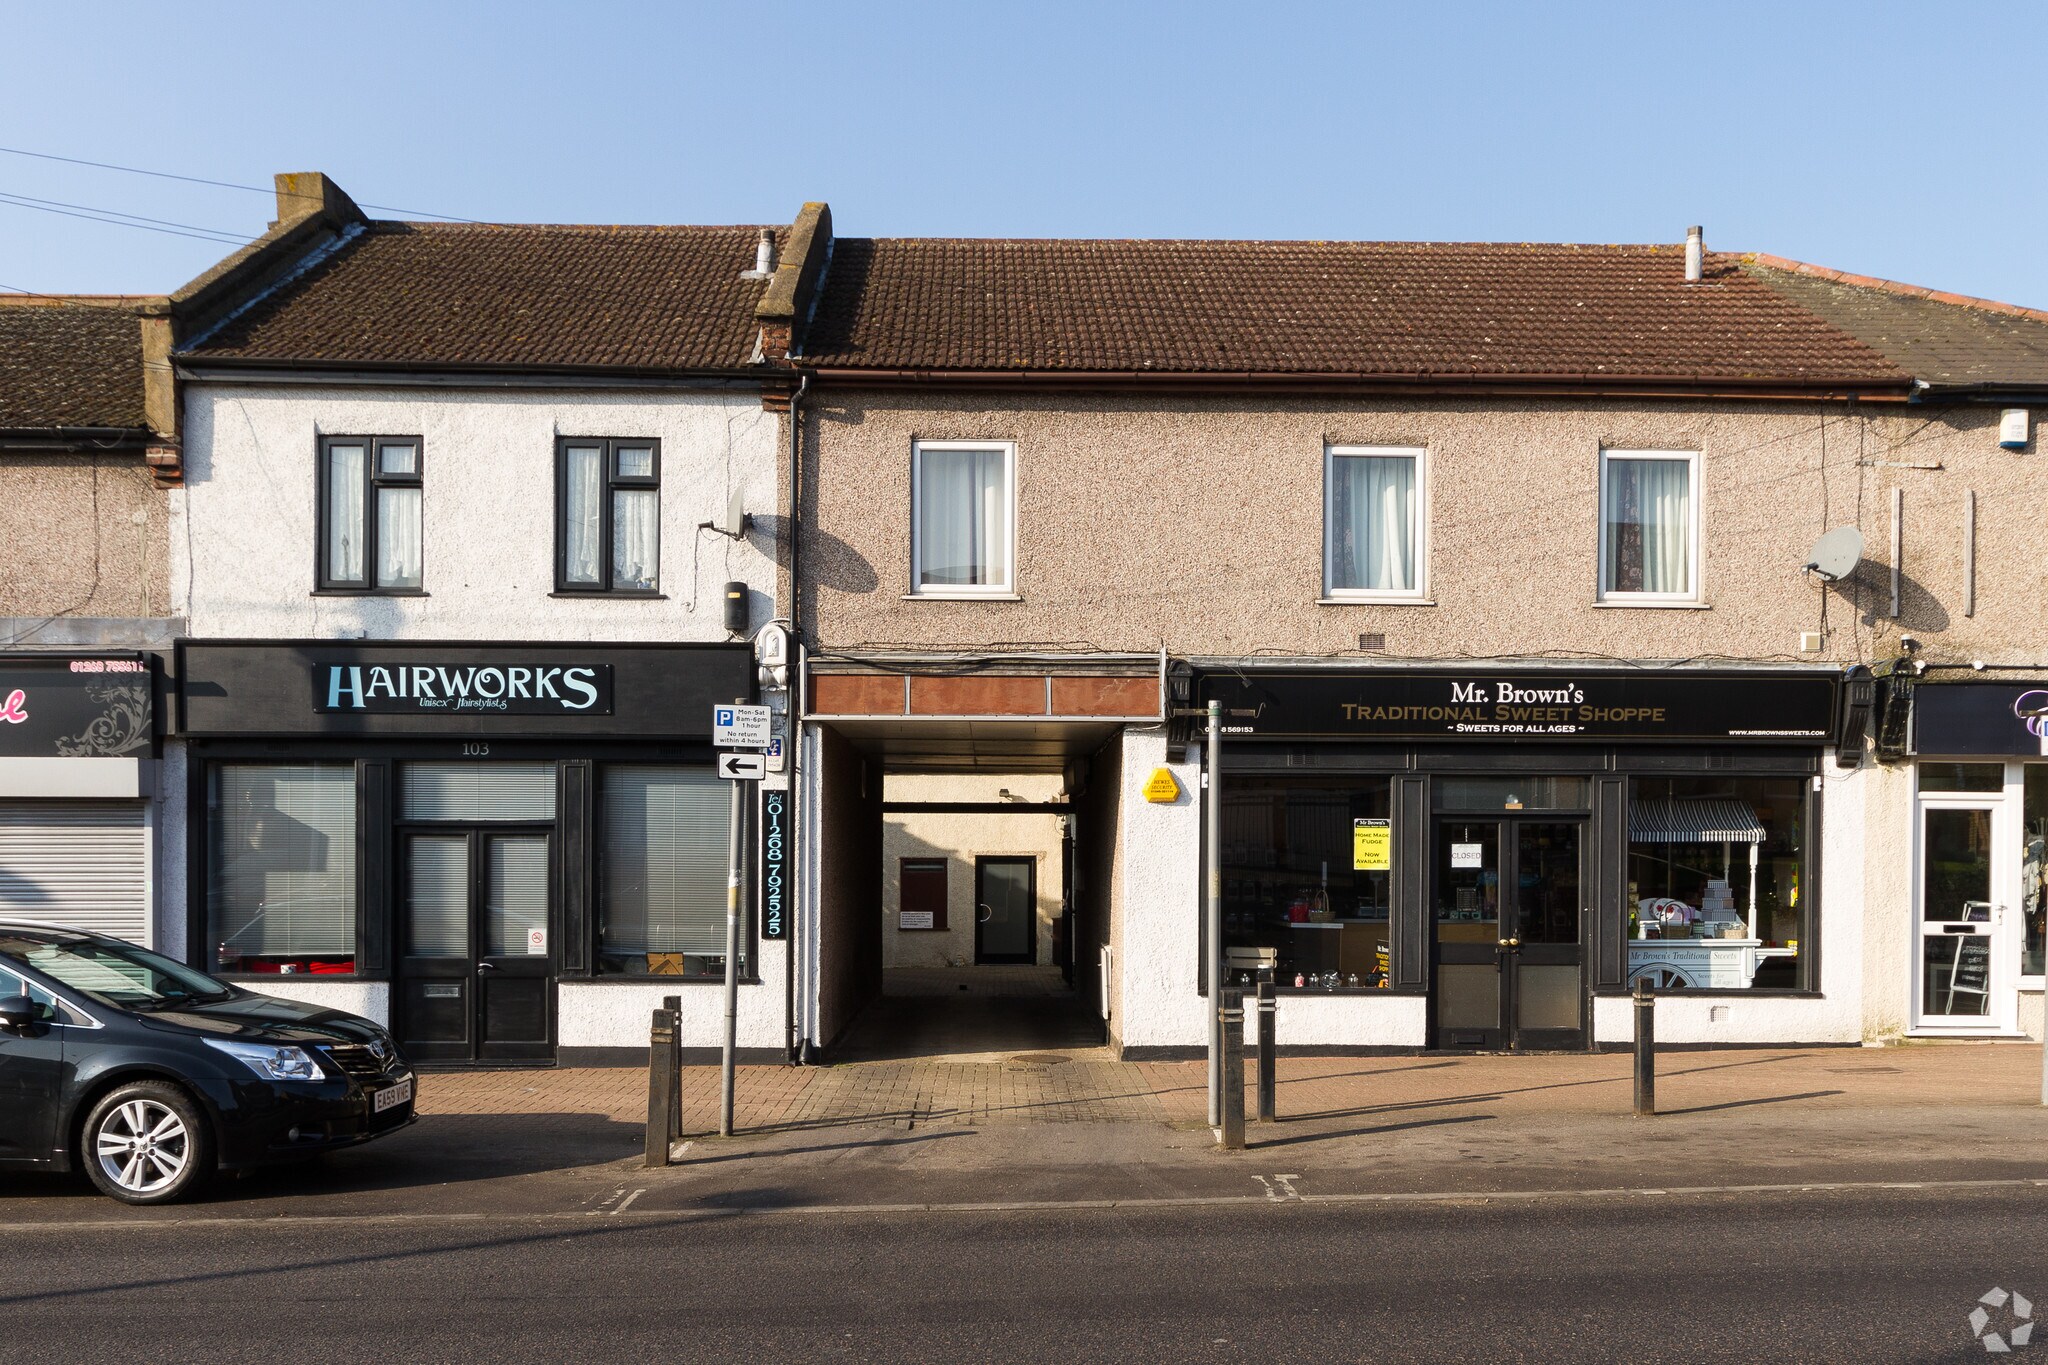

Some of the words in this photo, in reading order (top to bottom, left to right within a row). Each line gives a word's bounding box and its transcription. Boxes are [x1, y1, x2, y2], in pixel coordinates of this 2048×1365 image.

[327, 666, 598, 709] HAIRWORKS
[1450, 681, 1489, 703] Mr.
[1496, 682, 1584, 704] Brown's
[720, 711, 731, 725] P
[462, 742, 490, 756] 103
[1451, 852, 1481, 860] CLOSED
[1630, 951, 1641, 960] Mr
[1642, 951, 1671, 960] Brown's
[1672, 951, 1712, 960] Traditional
